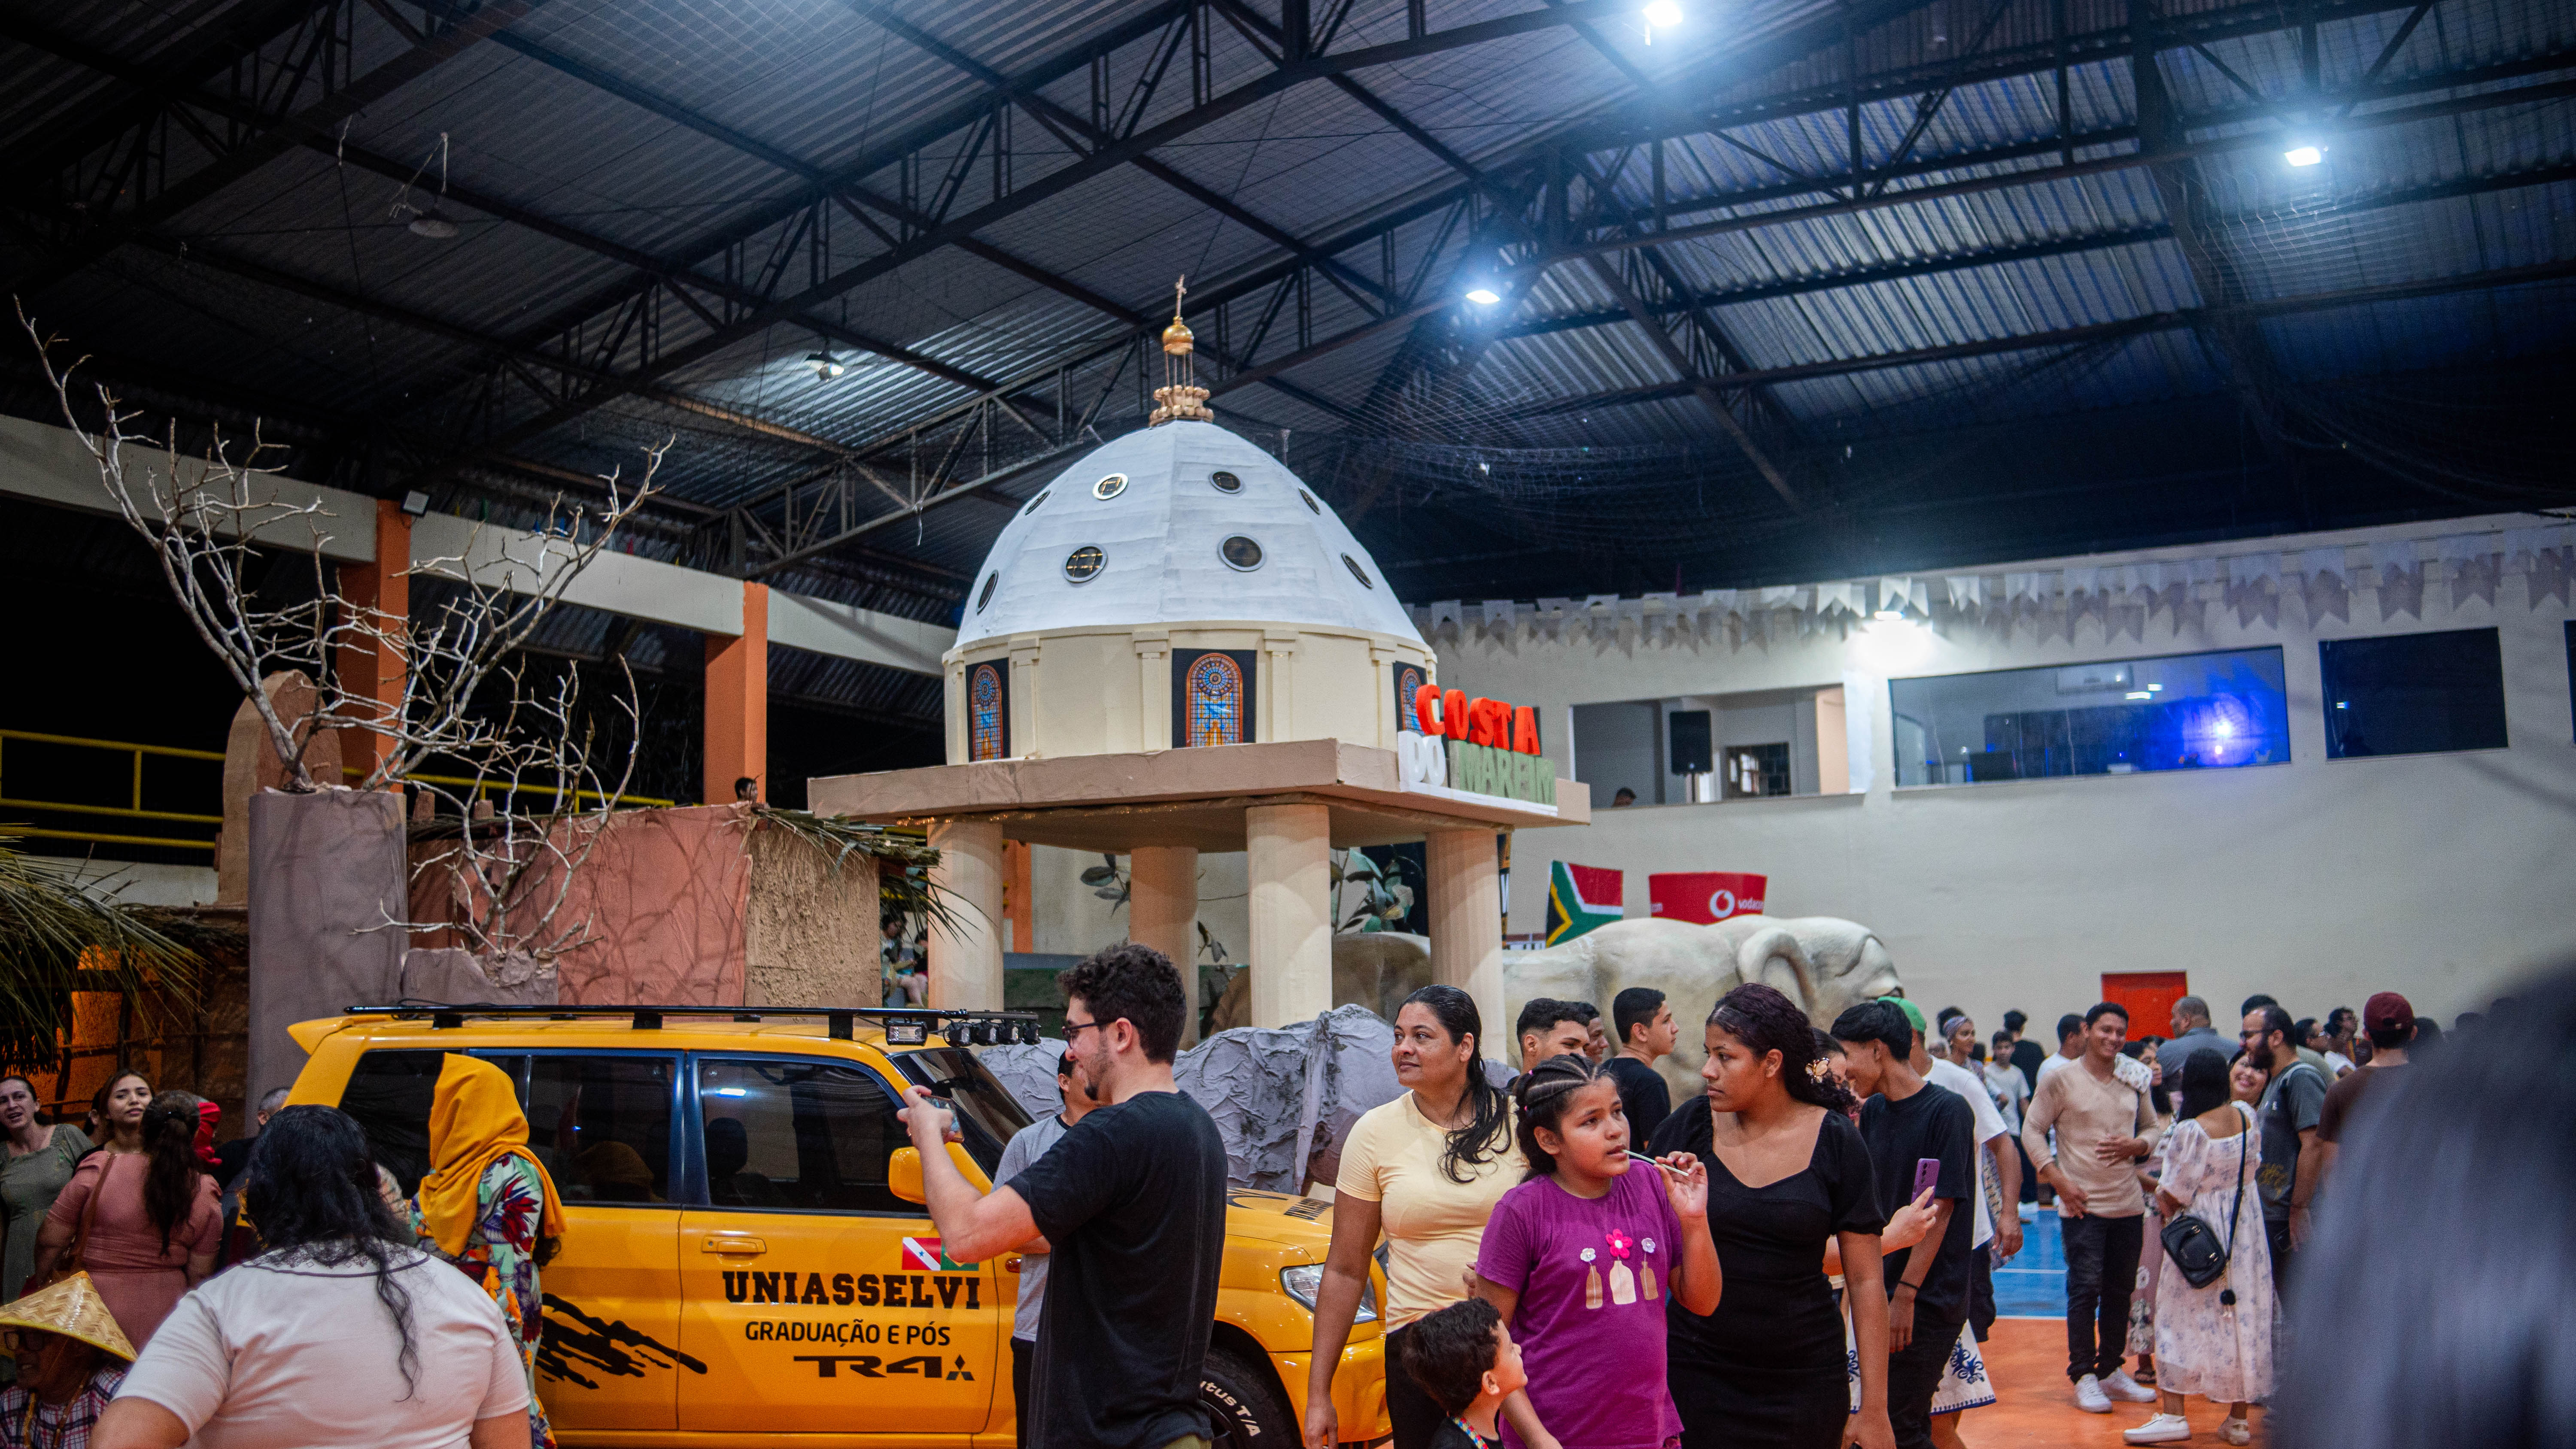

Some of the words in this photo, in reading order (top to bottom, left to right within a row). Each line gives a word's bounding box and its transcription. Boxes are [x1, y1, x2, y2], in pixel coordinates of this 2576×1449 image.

[1416, 684, 1540, 755] COSTA
[1398, 731, 1446, 786] DO
[1449, 740, 1556, 807] MARFIM
[723, 1271, 980, 1310] UNIASSELVI
[746, 1319, 880, 1347] GRADUAÇÃO
[888, 1325, 899, 1344] E
[906, 1321, 951, 1346] PÓS
[793, 1355, 943, 1378] TR4
